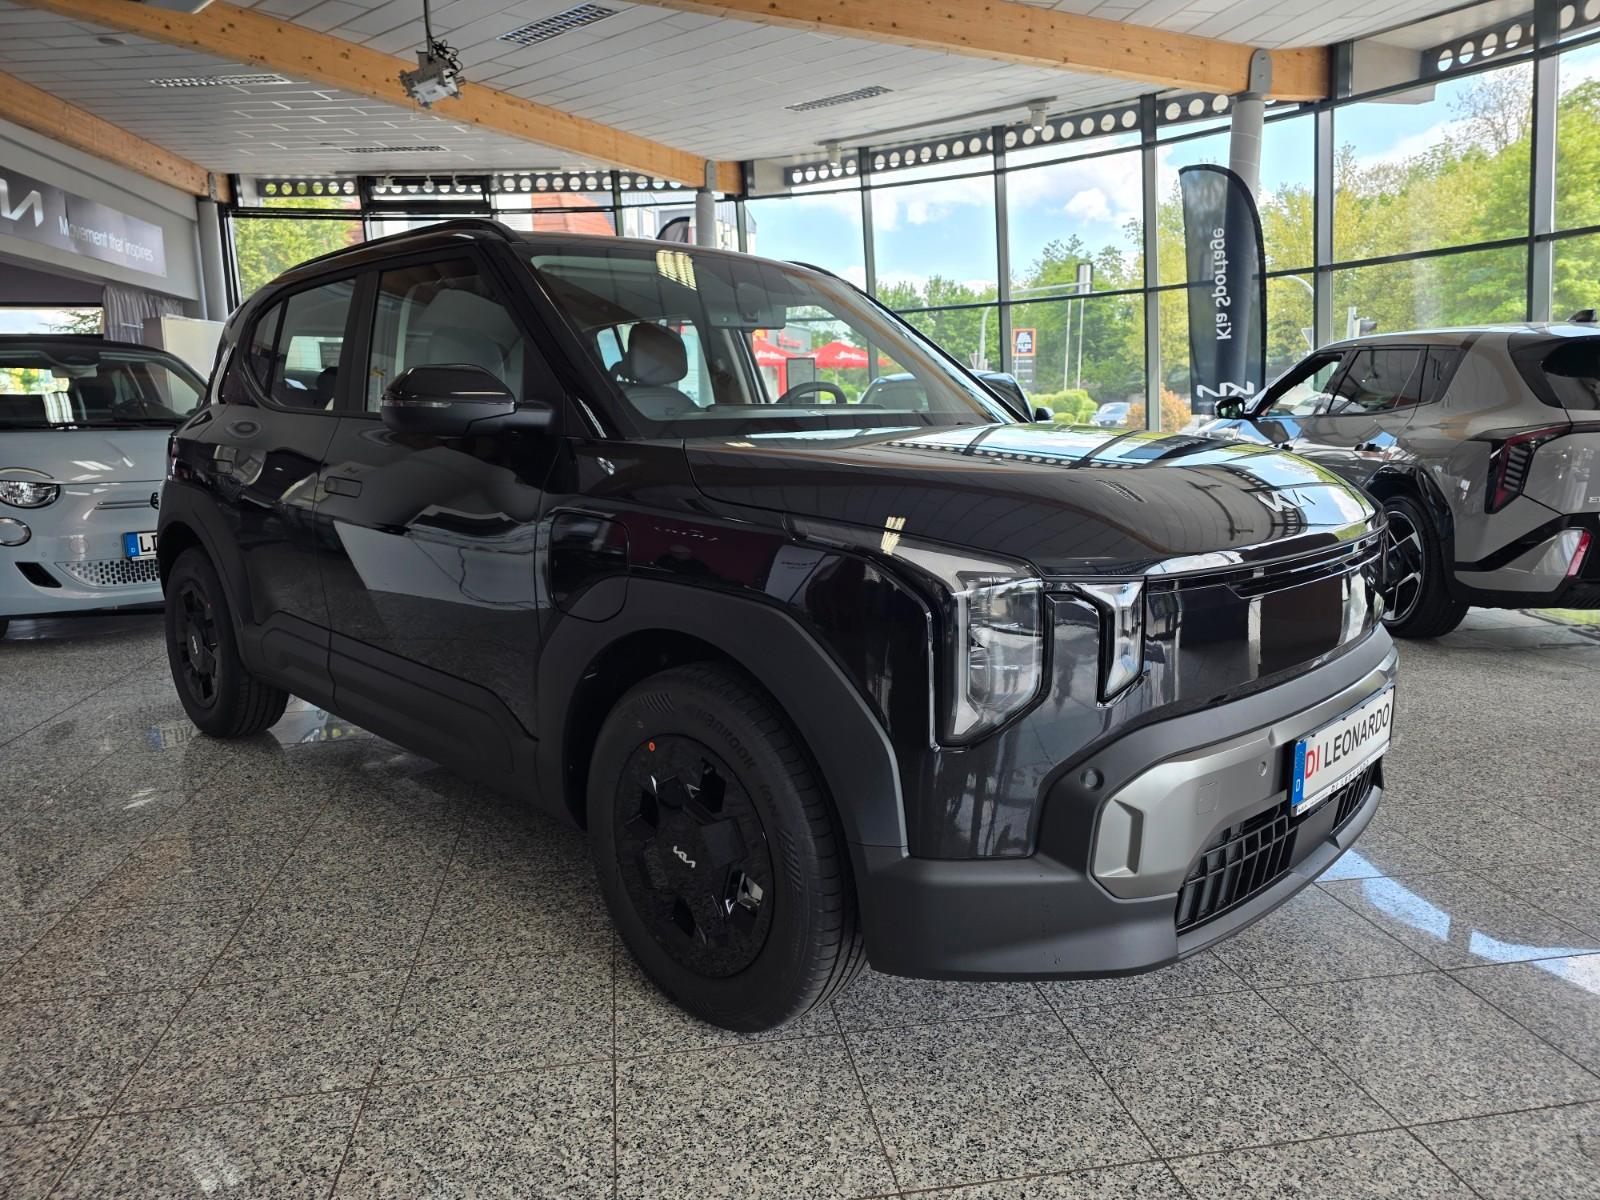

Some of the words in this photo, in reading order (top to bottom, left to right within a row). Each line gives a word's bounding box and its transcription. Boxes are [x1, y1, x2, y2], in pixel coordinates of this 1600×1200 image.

[58, 215, 107, 248] Movement
[109, 232, 124, 253] that
[125, 241, 155, 262] inspires
[1304, 744, 1321, 780] DI
[1323, 702, 1390, 769] LEONARDO
